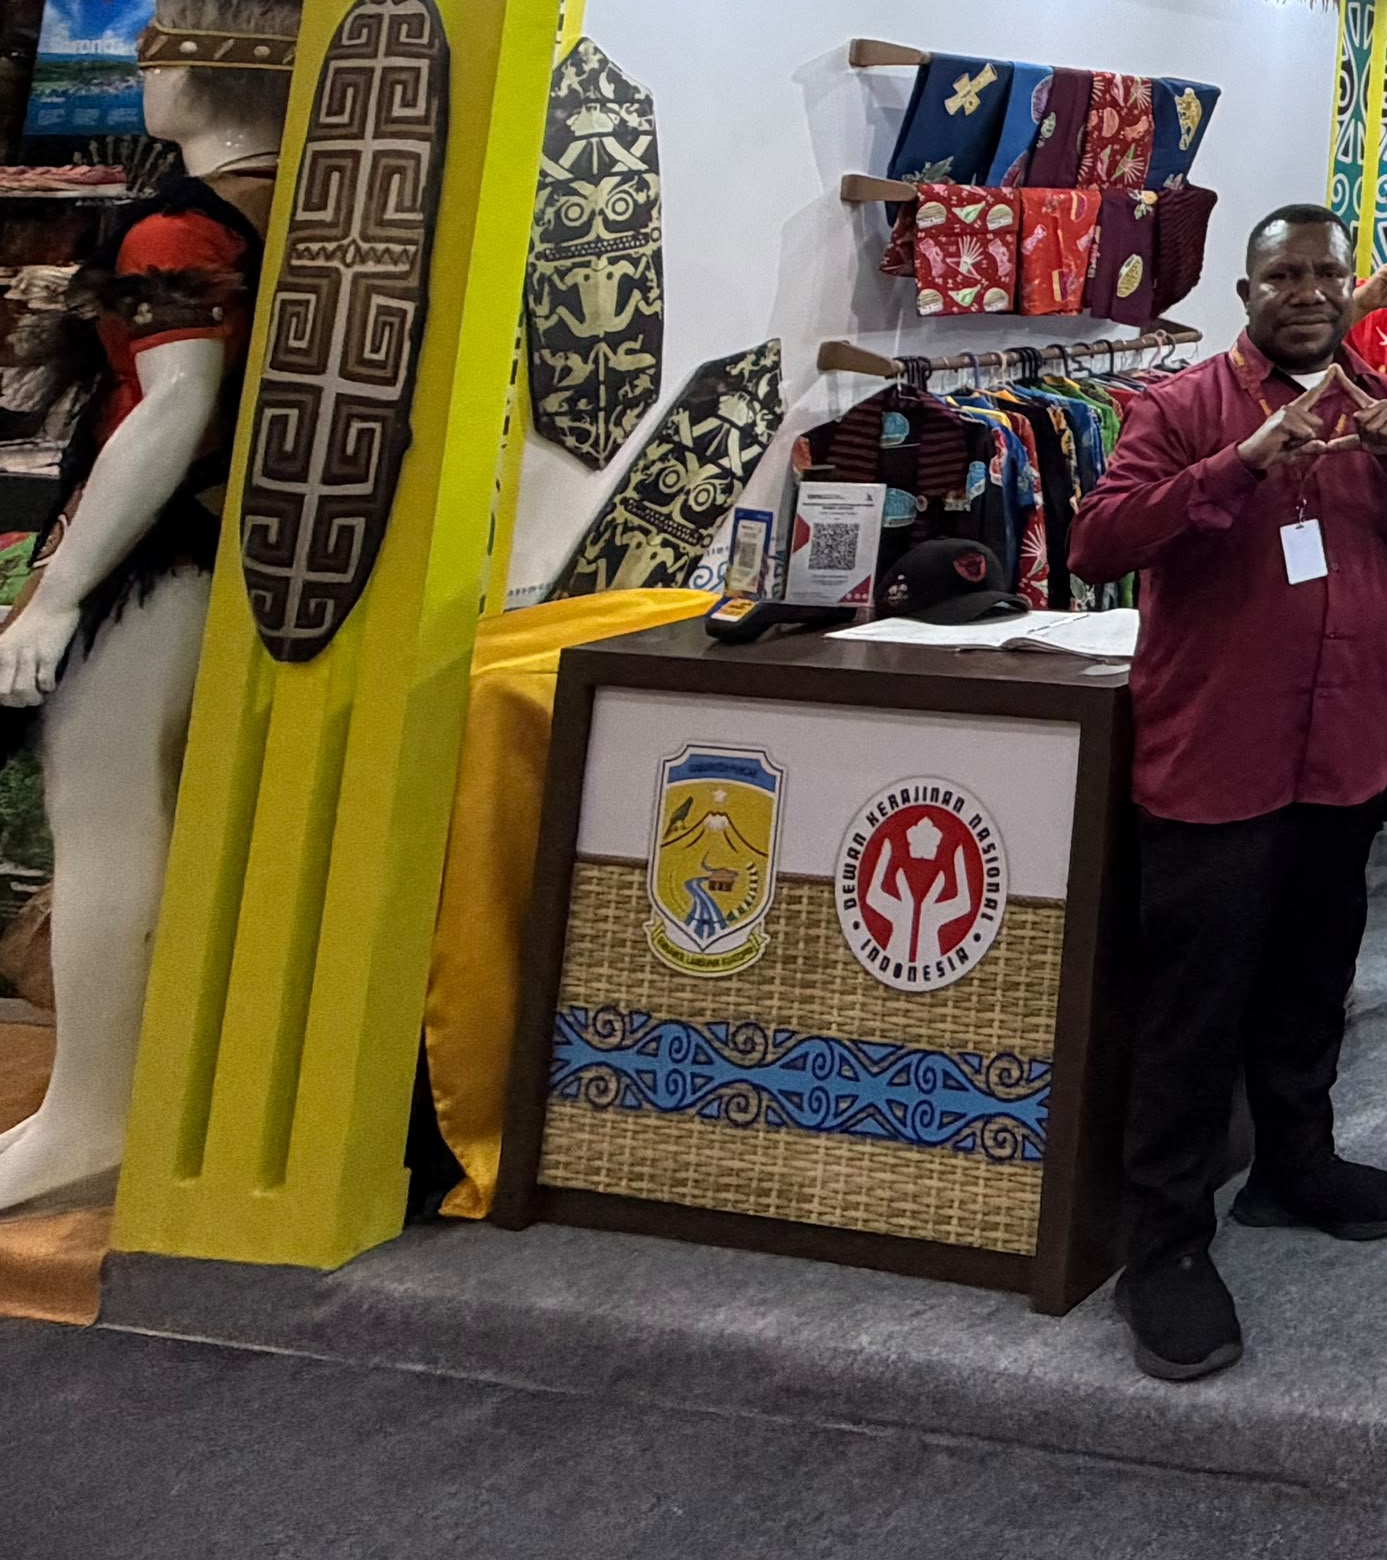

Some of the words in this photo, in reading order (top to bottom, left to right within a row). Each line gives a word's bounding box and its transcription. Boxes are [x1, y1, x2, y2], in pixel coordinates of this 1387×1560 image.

[842, 831, 867, 911] DEWAN
[865, 785, 966, 828] KERAJINAN
[967, 812, 1001, 923] NASIONAL
[859, 938, 970, 983] INDONESIA
